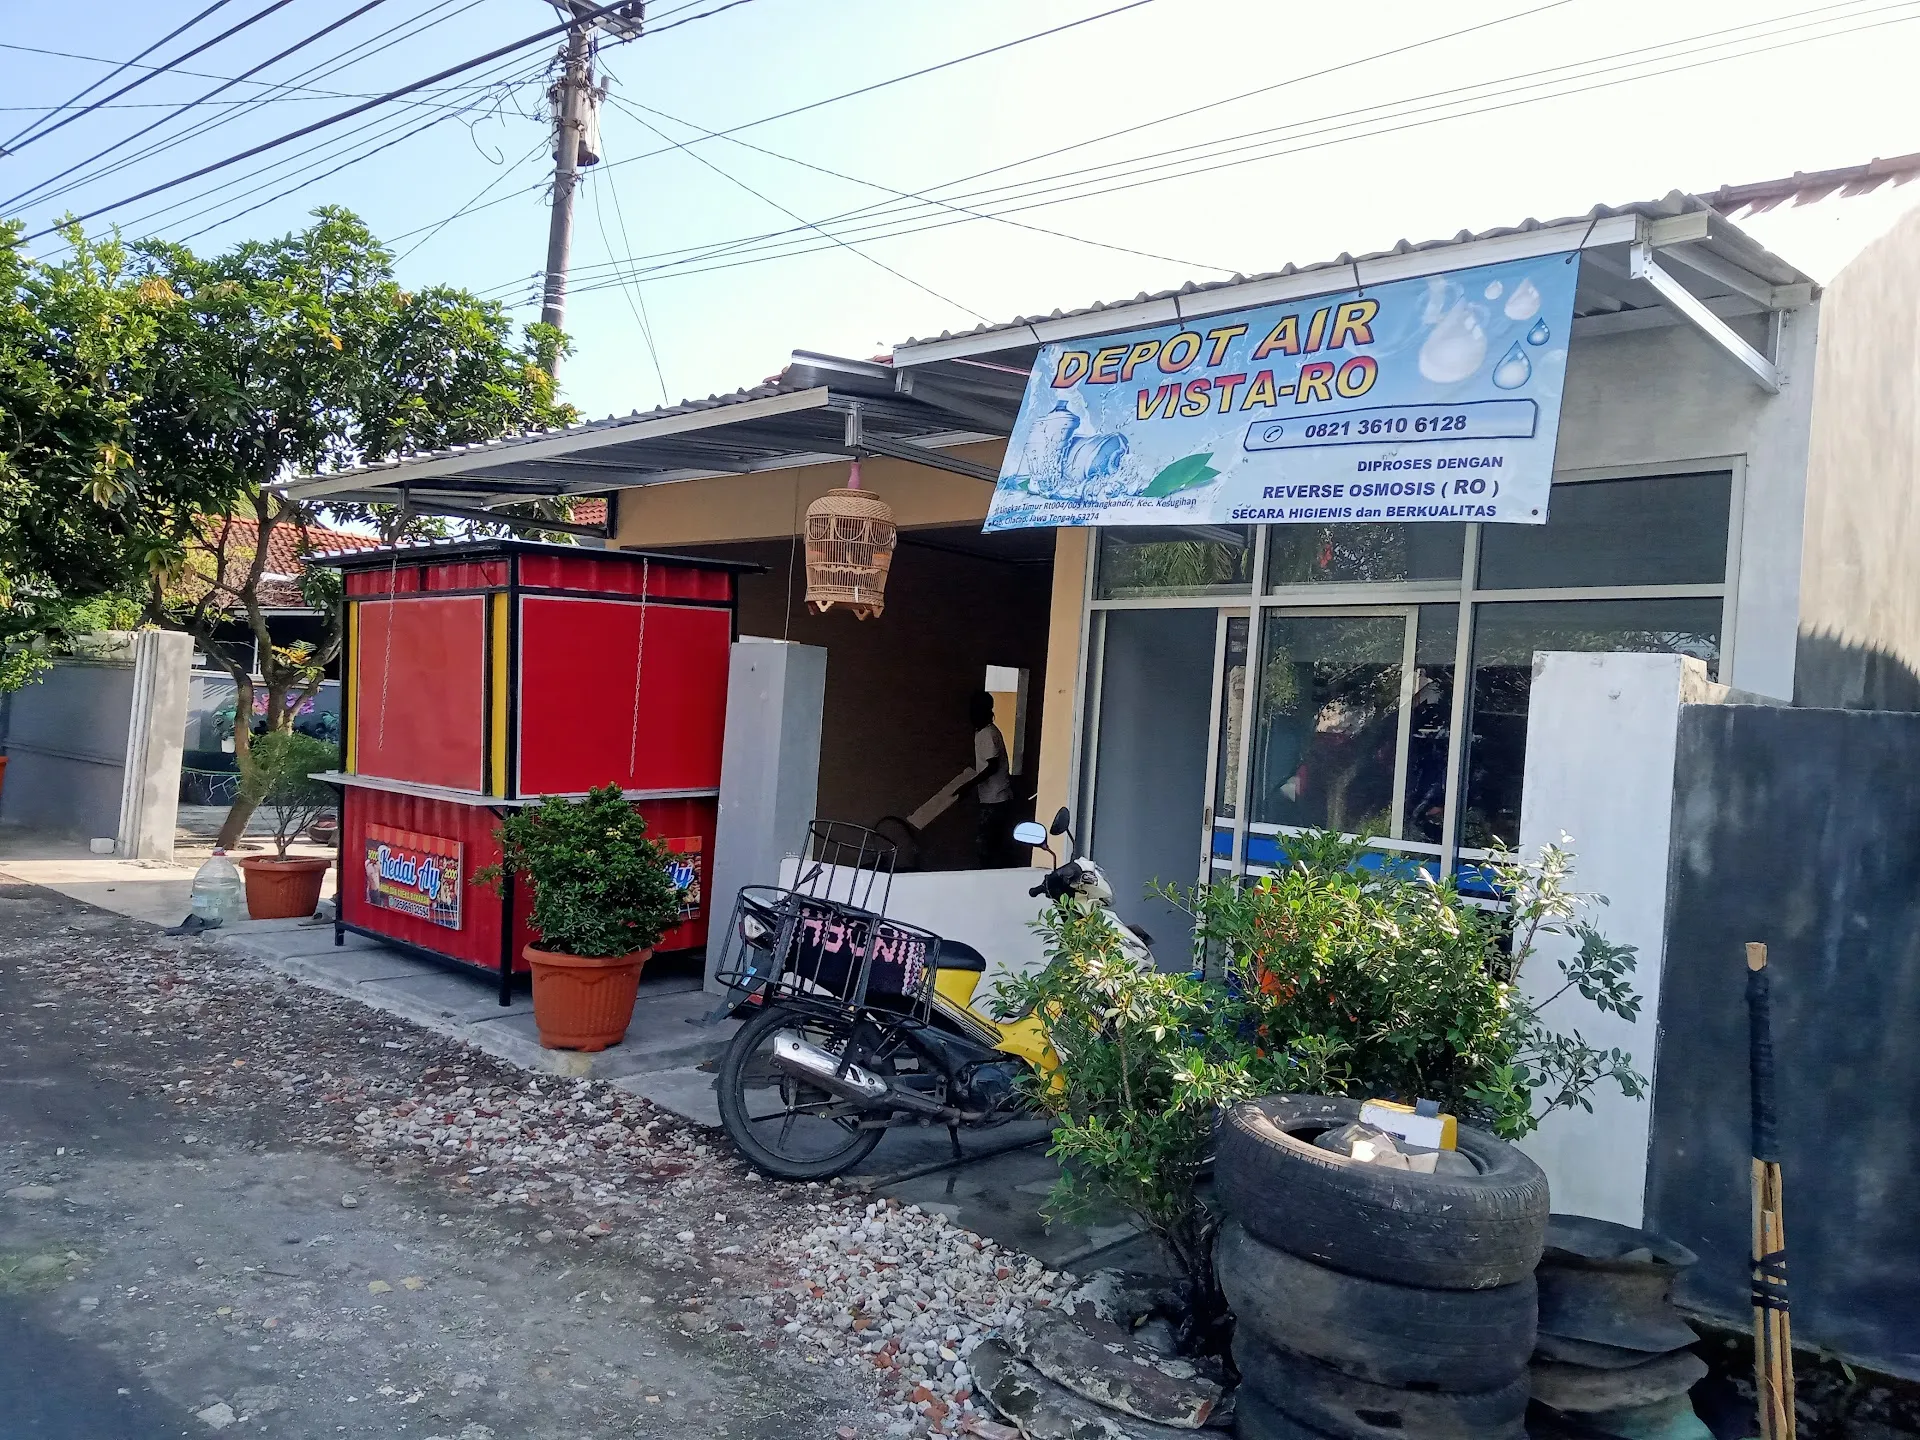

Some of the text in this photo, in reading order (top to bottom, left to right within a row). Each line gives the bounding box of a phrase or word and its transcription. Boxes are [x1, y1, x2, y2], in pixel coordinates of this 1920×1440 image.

[1050, 298, 1380, 389] DEPOT AIR
[1136, 355, 1379, 421] VISTA-RO
[1305, 415, 1467, 438] 0821 3610 6128
[1357, 456, 1504, 472] DIPROSES DENGAN
[1262, 484, 1344, 499] REVERSE
[1349, 481, 1435, 498] OSMOSIS
[1453, 478, 1486, 496] RO
[1022, 502, 1042, 511] Timur
[1136, 499, 1154, 507] Kec.
[1155, 497, 1197, 509] Kesugihan
[1231, 504, 1497, 519] SECARA HIGIENIS dan BERKUALITAS
[1029, 514, 1047, 522] Jawa
[1049, 513, 1075, 522] Tengah
[1076, 512, 1100, 521] 53274
[379, 847, 417, 885] Kedai
[418, 857, 440, 900] Ay
